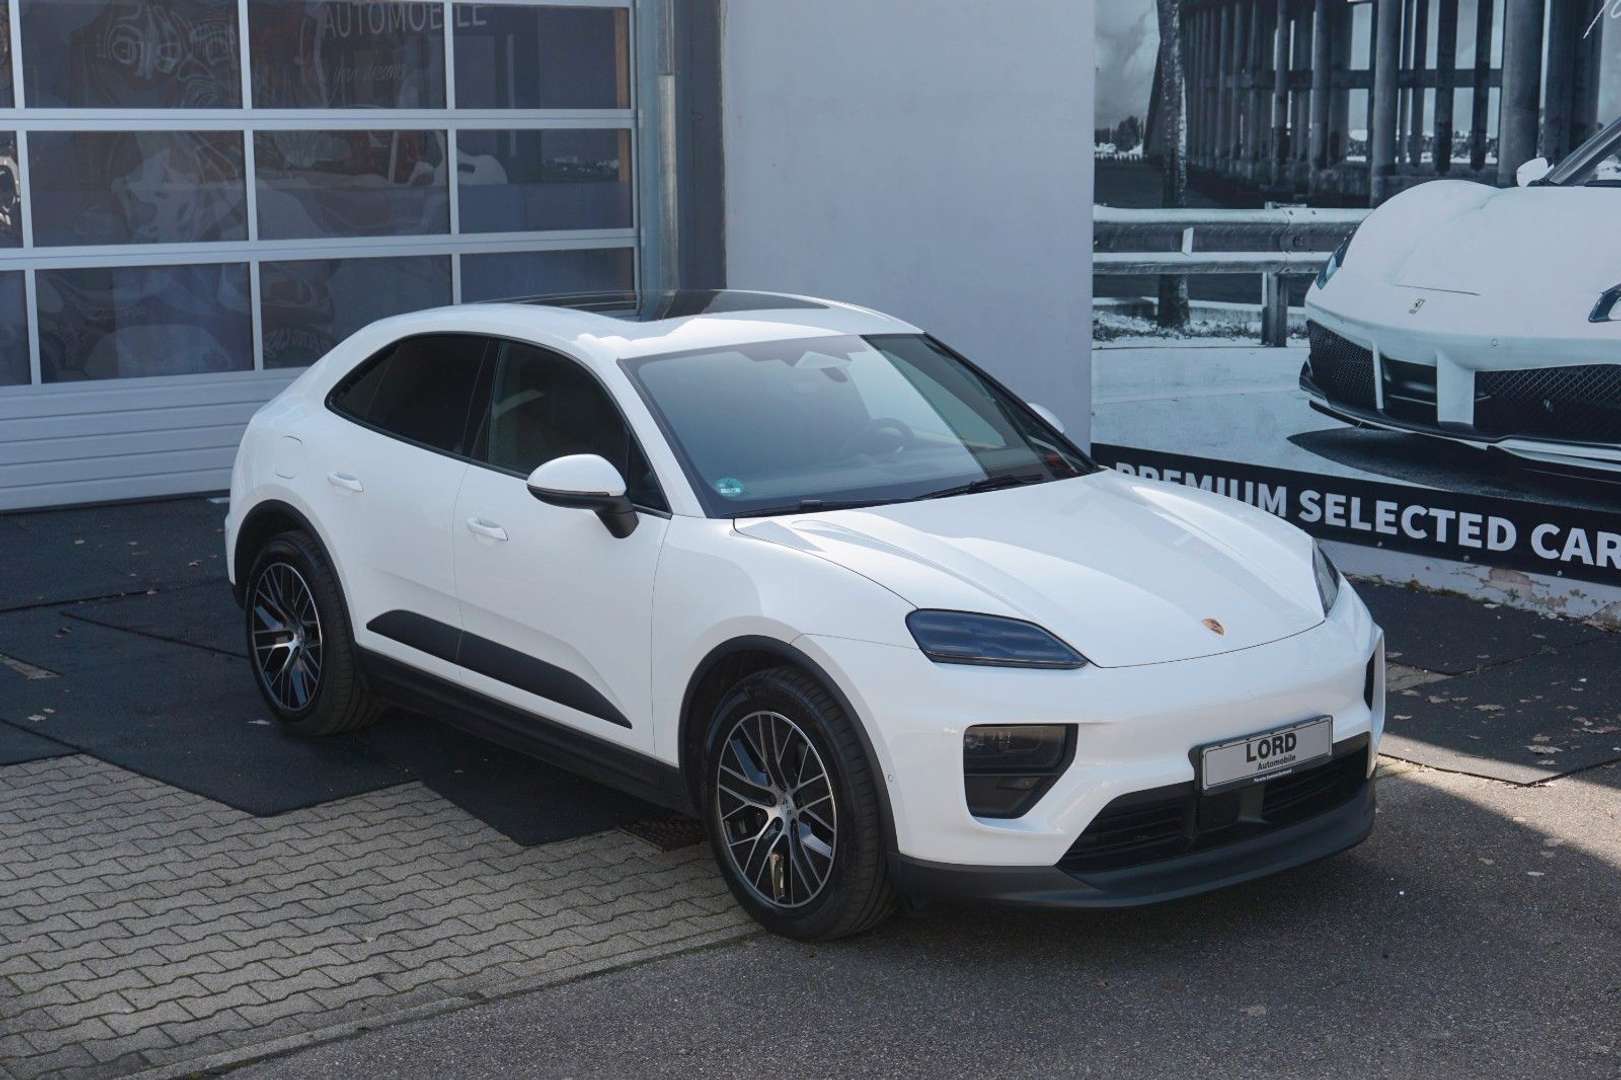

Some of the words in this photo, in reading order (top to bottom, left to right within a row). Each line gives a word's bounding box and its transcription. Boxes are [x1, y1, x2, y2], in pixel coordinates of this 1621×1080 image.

[323, 3, 487, 37] AUTOMOBLE
[1298, 489, 1517, 552] SELECTED
[1531, 523, 1621, 570] CAR
[1246, 733, 1297, 762] LORD
[1257, 754, 1296, 770] Automobile
